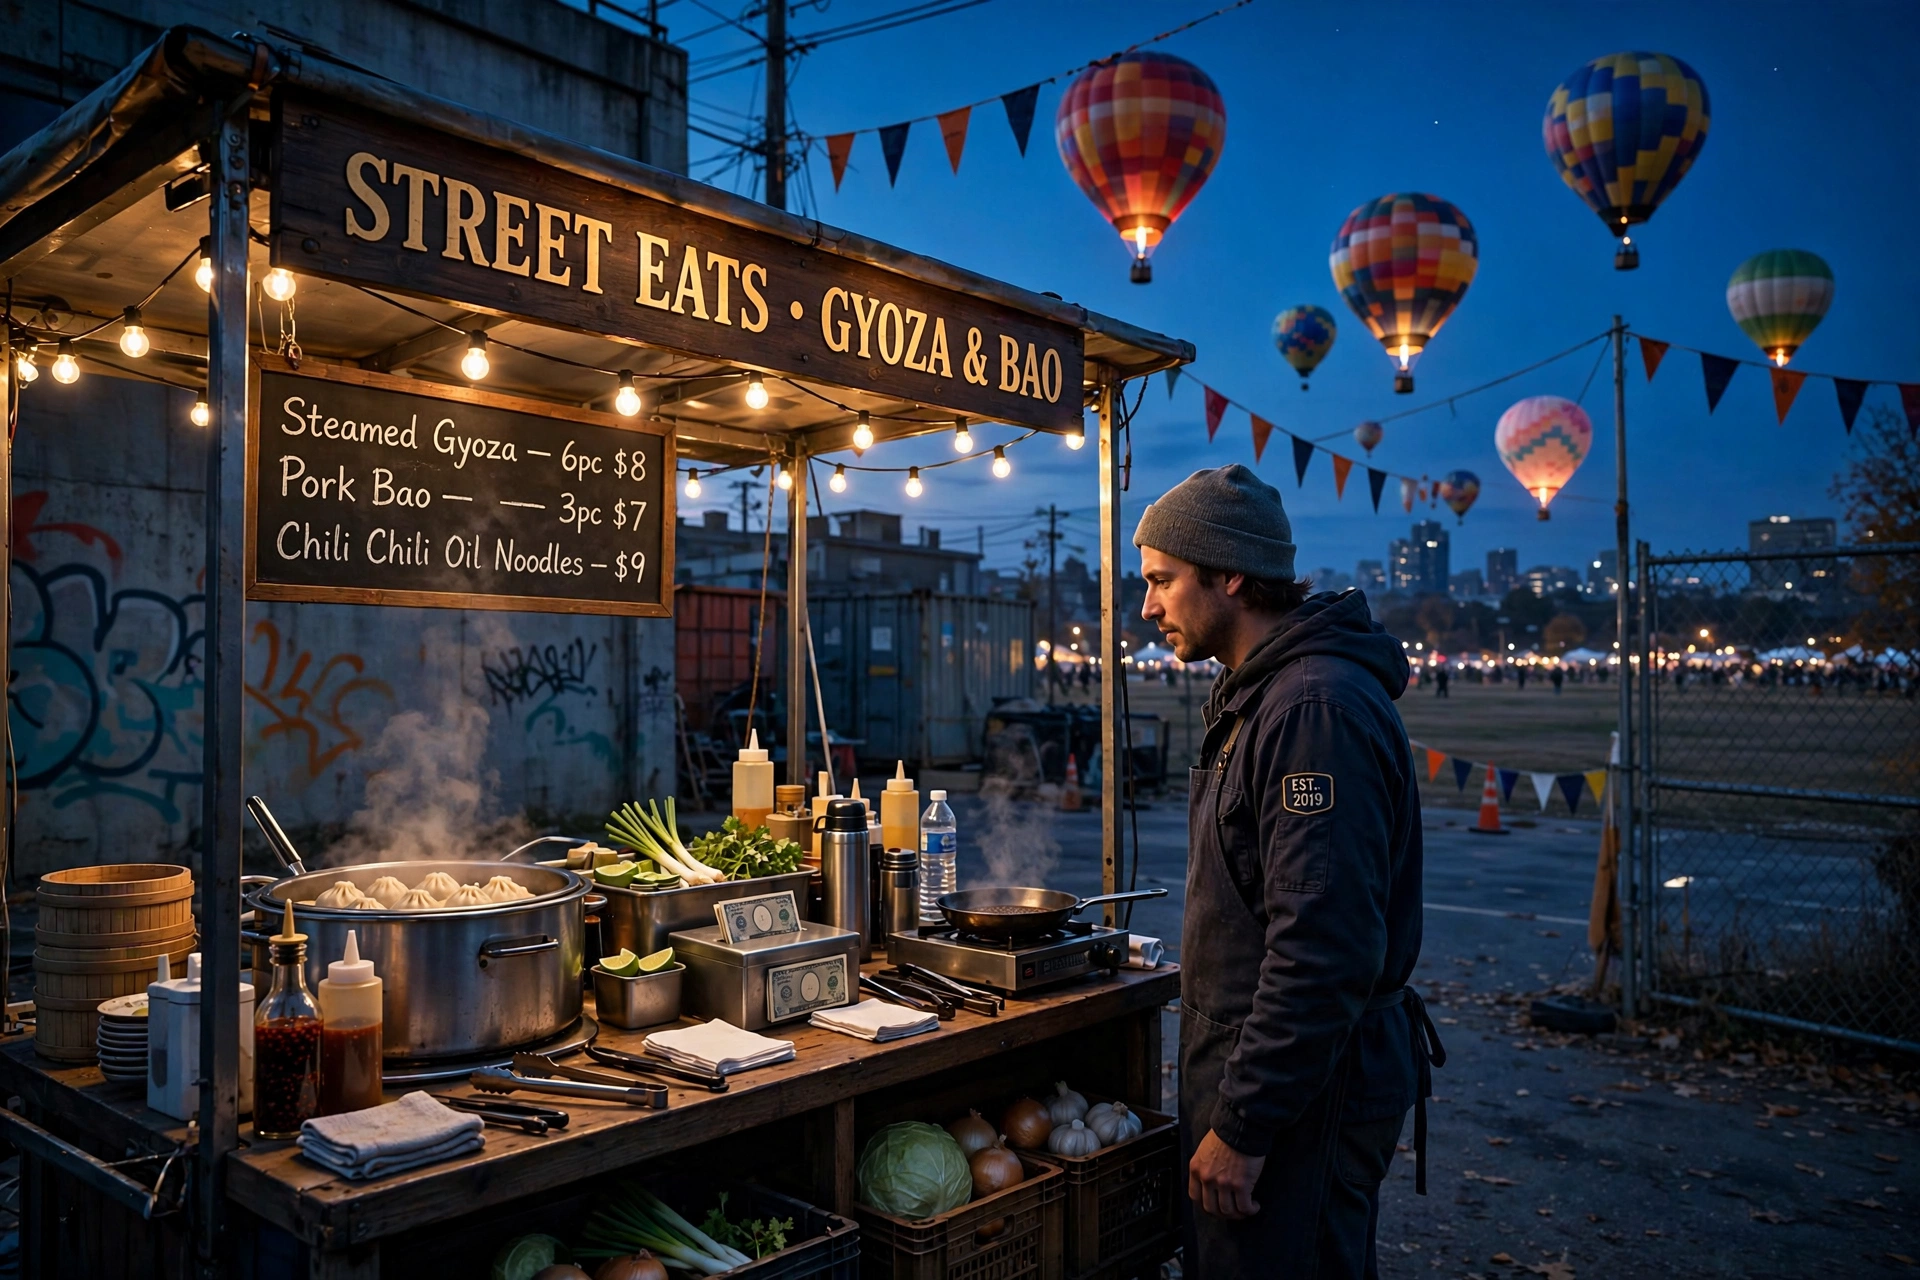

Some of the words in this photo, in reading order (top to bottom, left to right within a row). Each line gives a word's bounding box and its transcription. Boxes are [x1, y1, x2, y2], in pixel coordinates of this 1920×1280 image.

[345, 151, 612, 294] STREET
[635, 231, 769, 333] EATS
[821, 286, 953, 378] GYOZA
[963, 326, 988, 387] &
[998, 334, 1063, 403] BAO
[281, 396, 418, 450] Steamed
[433, 418, 518, 469] Gyoza
[561, 440, 603, 481] 6pc
[614, 448, 646, 482] $8
[279, 455, 356, 502] Pork
[372, 467, 431, 508] Bao
[559, 492, 602, 534] 3pc
[613, 498, 647, 531] $7
[276, 520, 350, 562] Chili
[366, 527, 430, 566] Chili
[445, 534, 482, 570] Oil
[494, 538, 584, 576] Noodles
[615, 550, 646, 584] $9
[1293, 793, 1323, 807] 2019
